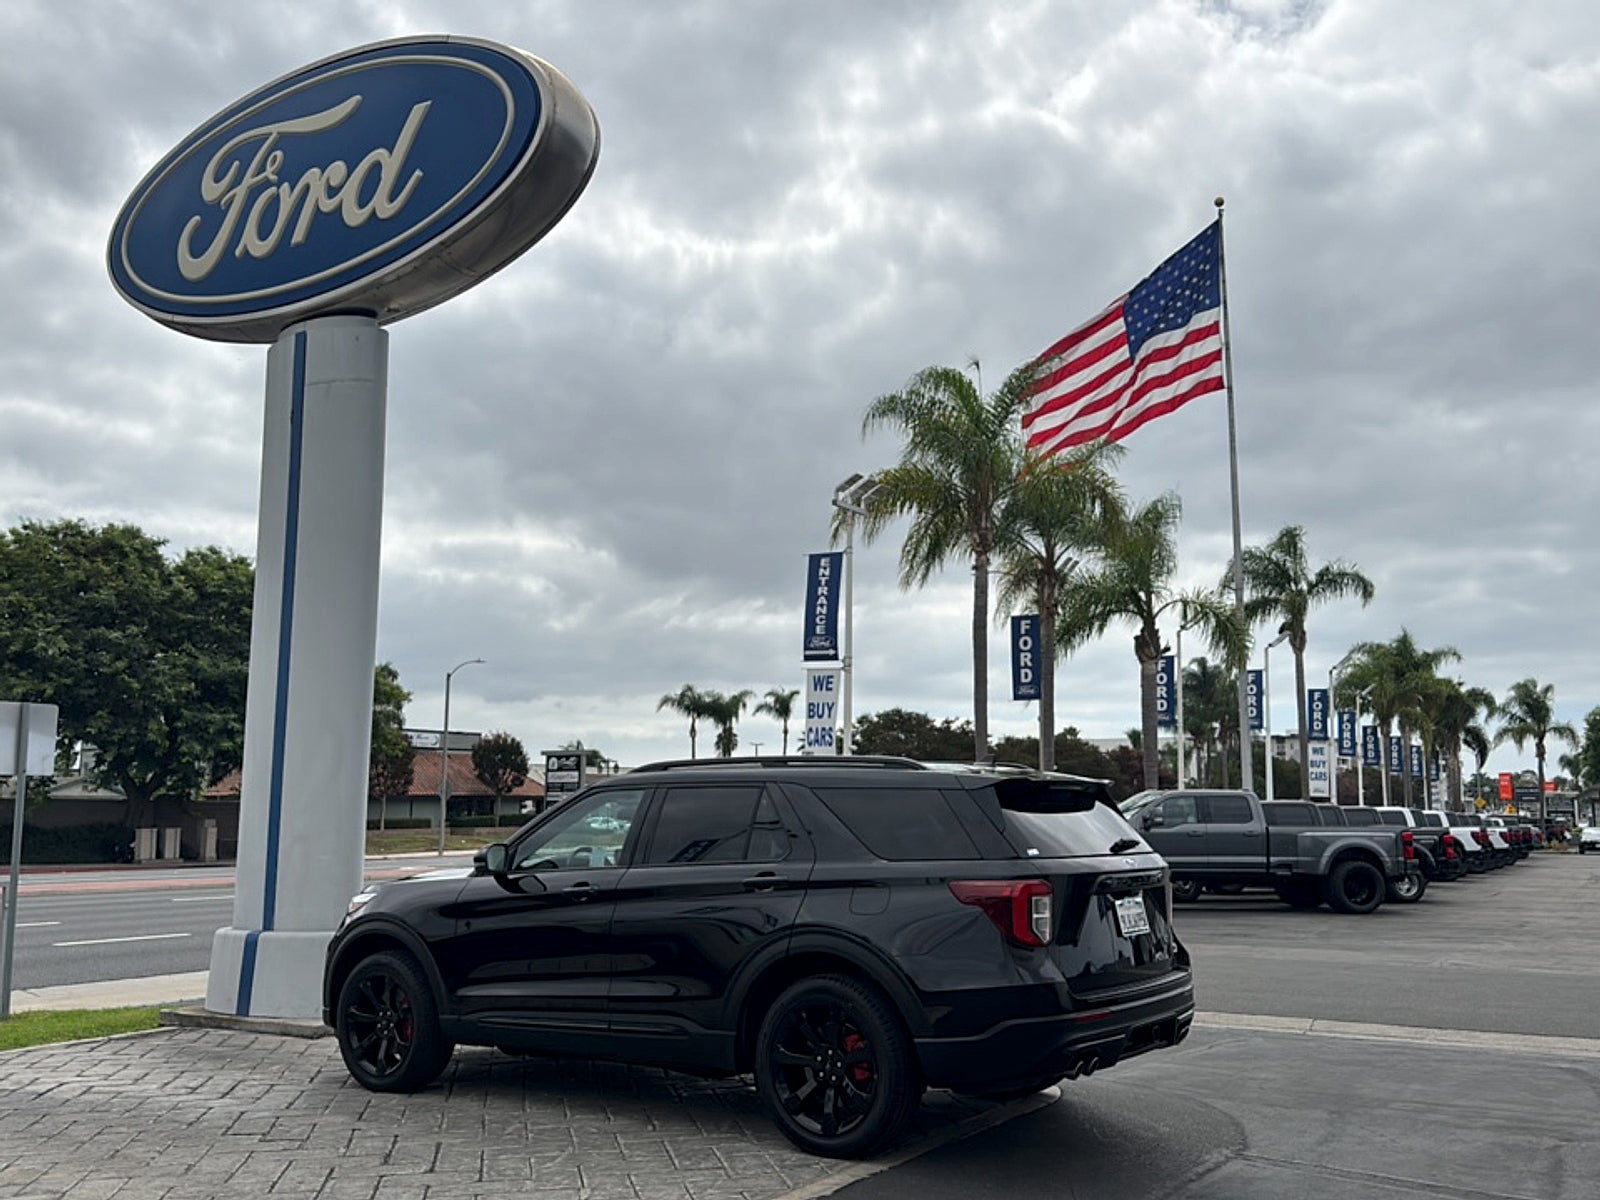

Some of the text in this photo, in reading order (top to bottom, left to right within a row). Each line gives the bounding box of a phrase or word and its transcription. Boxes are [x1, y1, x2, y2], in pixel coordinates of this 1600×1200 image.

[177, 95, 432, 281] Ford
[815, 557, 831, 635] ENTRANCE
[1018, 619, 1033, 684] FORD
[813, 675, 834, 692] WE
[1156, 660, 1168, 712] FORD
[1246, 673, 1258, 718] FORD
[808, 702, 835, 720] BUY
[1313, 691, 1323, 731] FORD
[807, 727, 833, 747] CARS
[1343, 713, 1352, 748] FORD
[1310, 760, 1327, 769] BUY
[1311, 747, 1325, 756] WE
[1310, 771, 1327, 780] CARS
